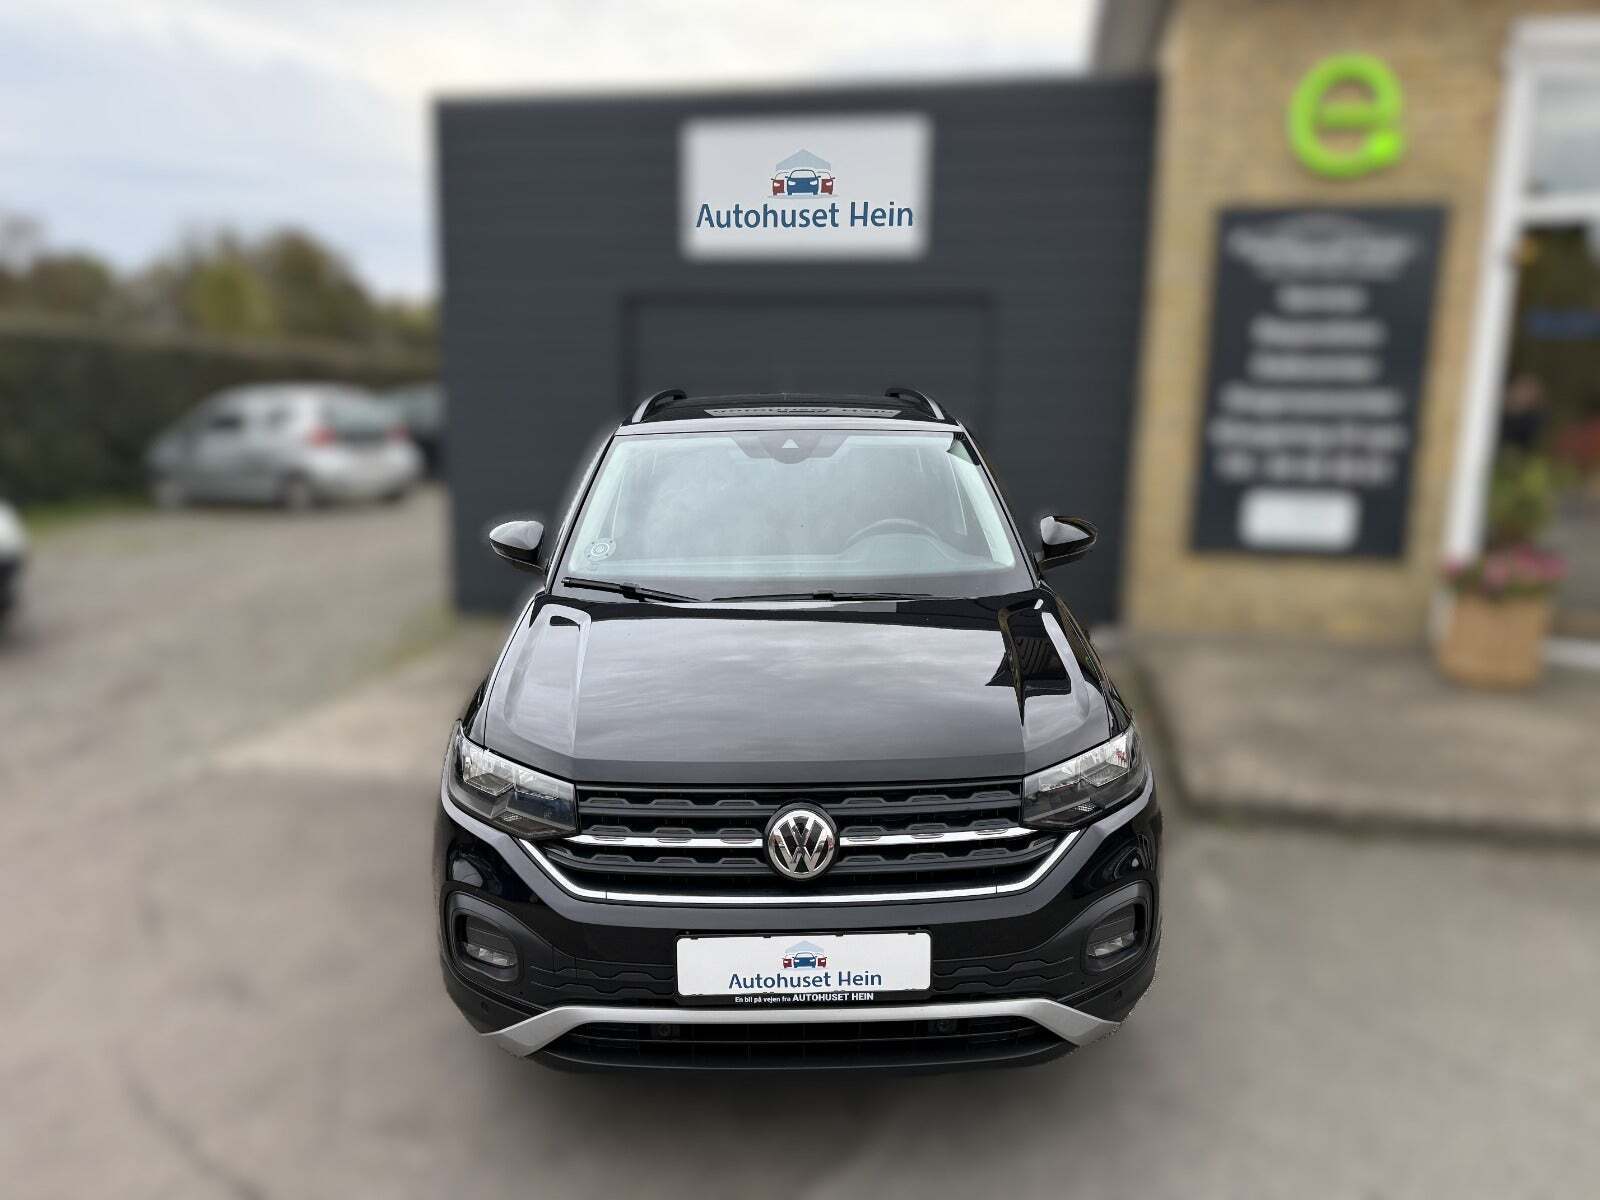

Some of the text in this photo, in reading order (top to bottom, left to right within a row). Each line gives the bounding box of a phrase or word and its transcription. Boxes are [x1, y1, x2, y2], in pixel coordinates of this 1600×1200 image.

[696, 201, 913, 228] Autohuset Hein
[729, 970, 882, 989] Autohuset Hein
[792, 993, 849, 1002] AUTOHUSET
[851, 992, 874, 1001] HEIN
